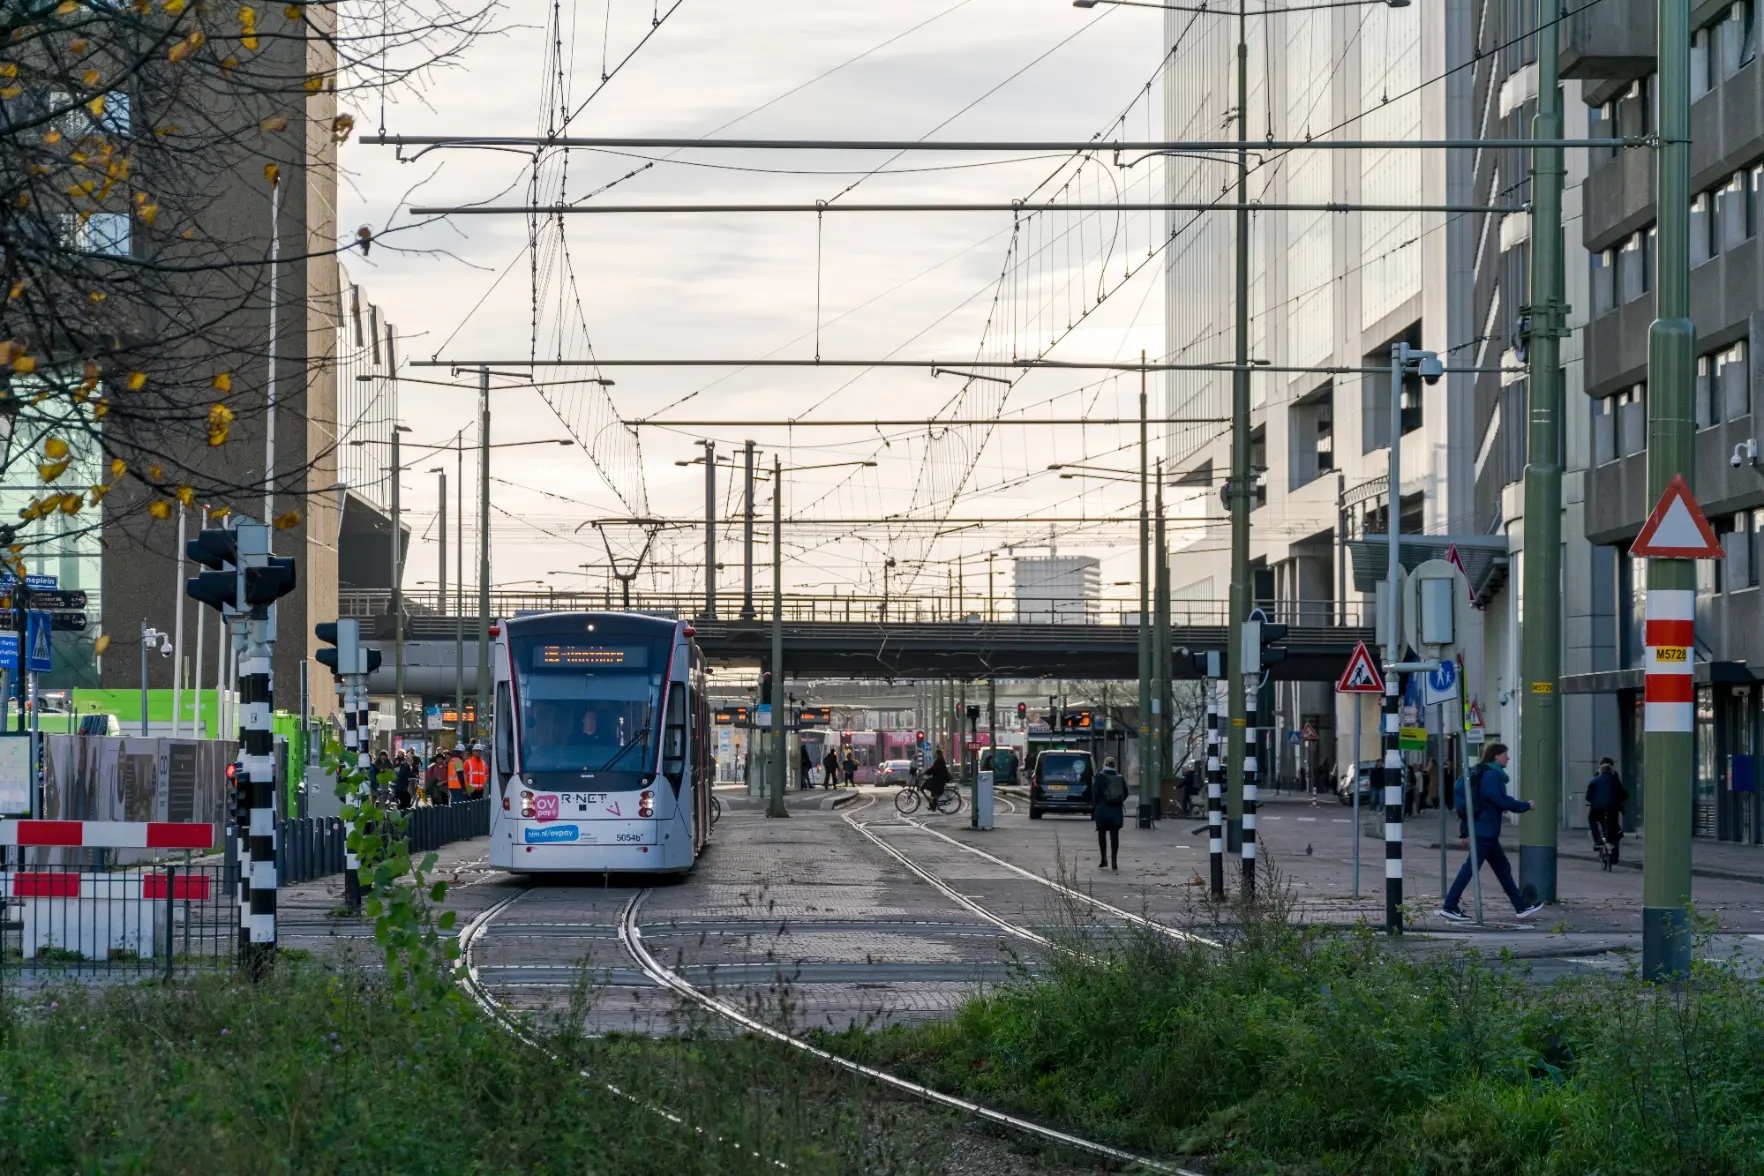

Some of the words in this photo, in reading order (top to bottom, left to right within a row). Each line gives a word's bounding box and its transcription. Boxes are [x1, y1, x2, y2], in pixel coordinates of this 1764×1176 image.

[1656, 649, 1687, 660] M5728
[536, 798, 556, 809] OV
[616, 833, 641, 842] 5054b
